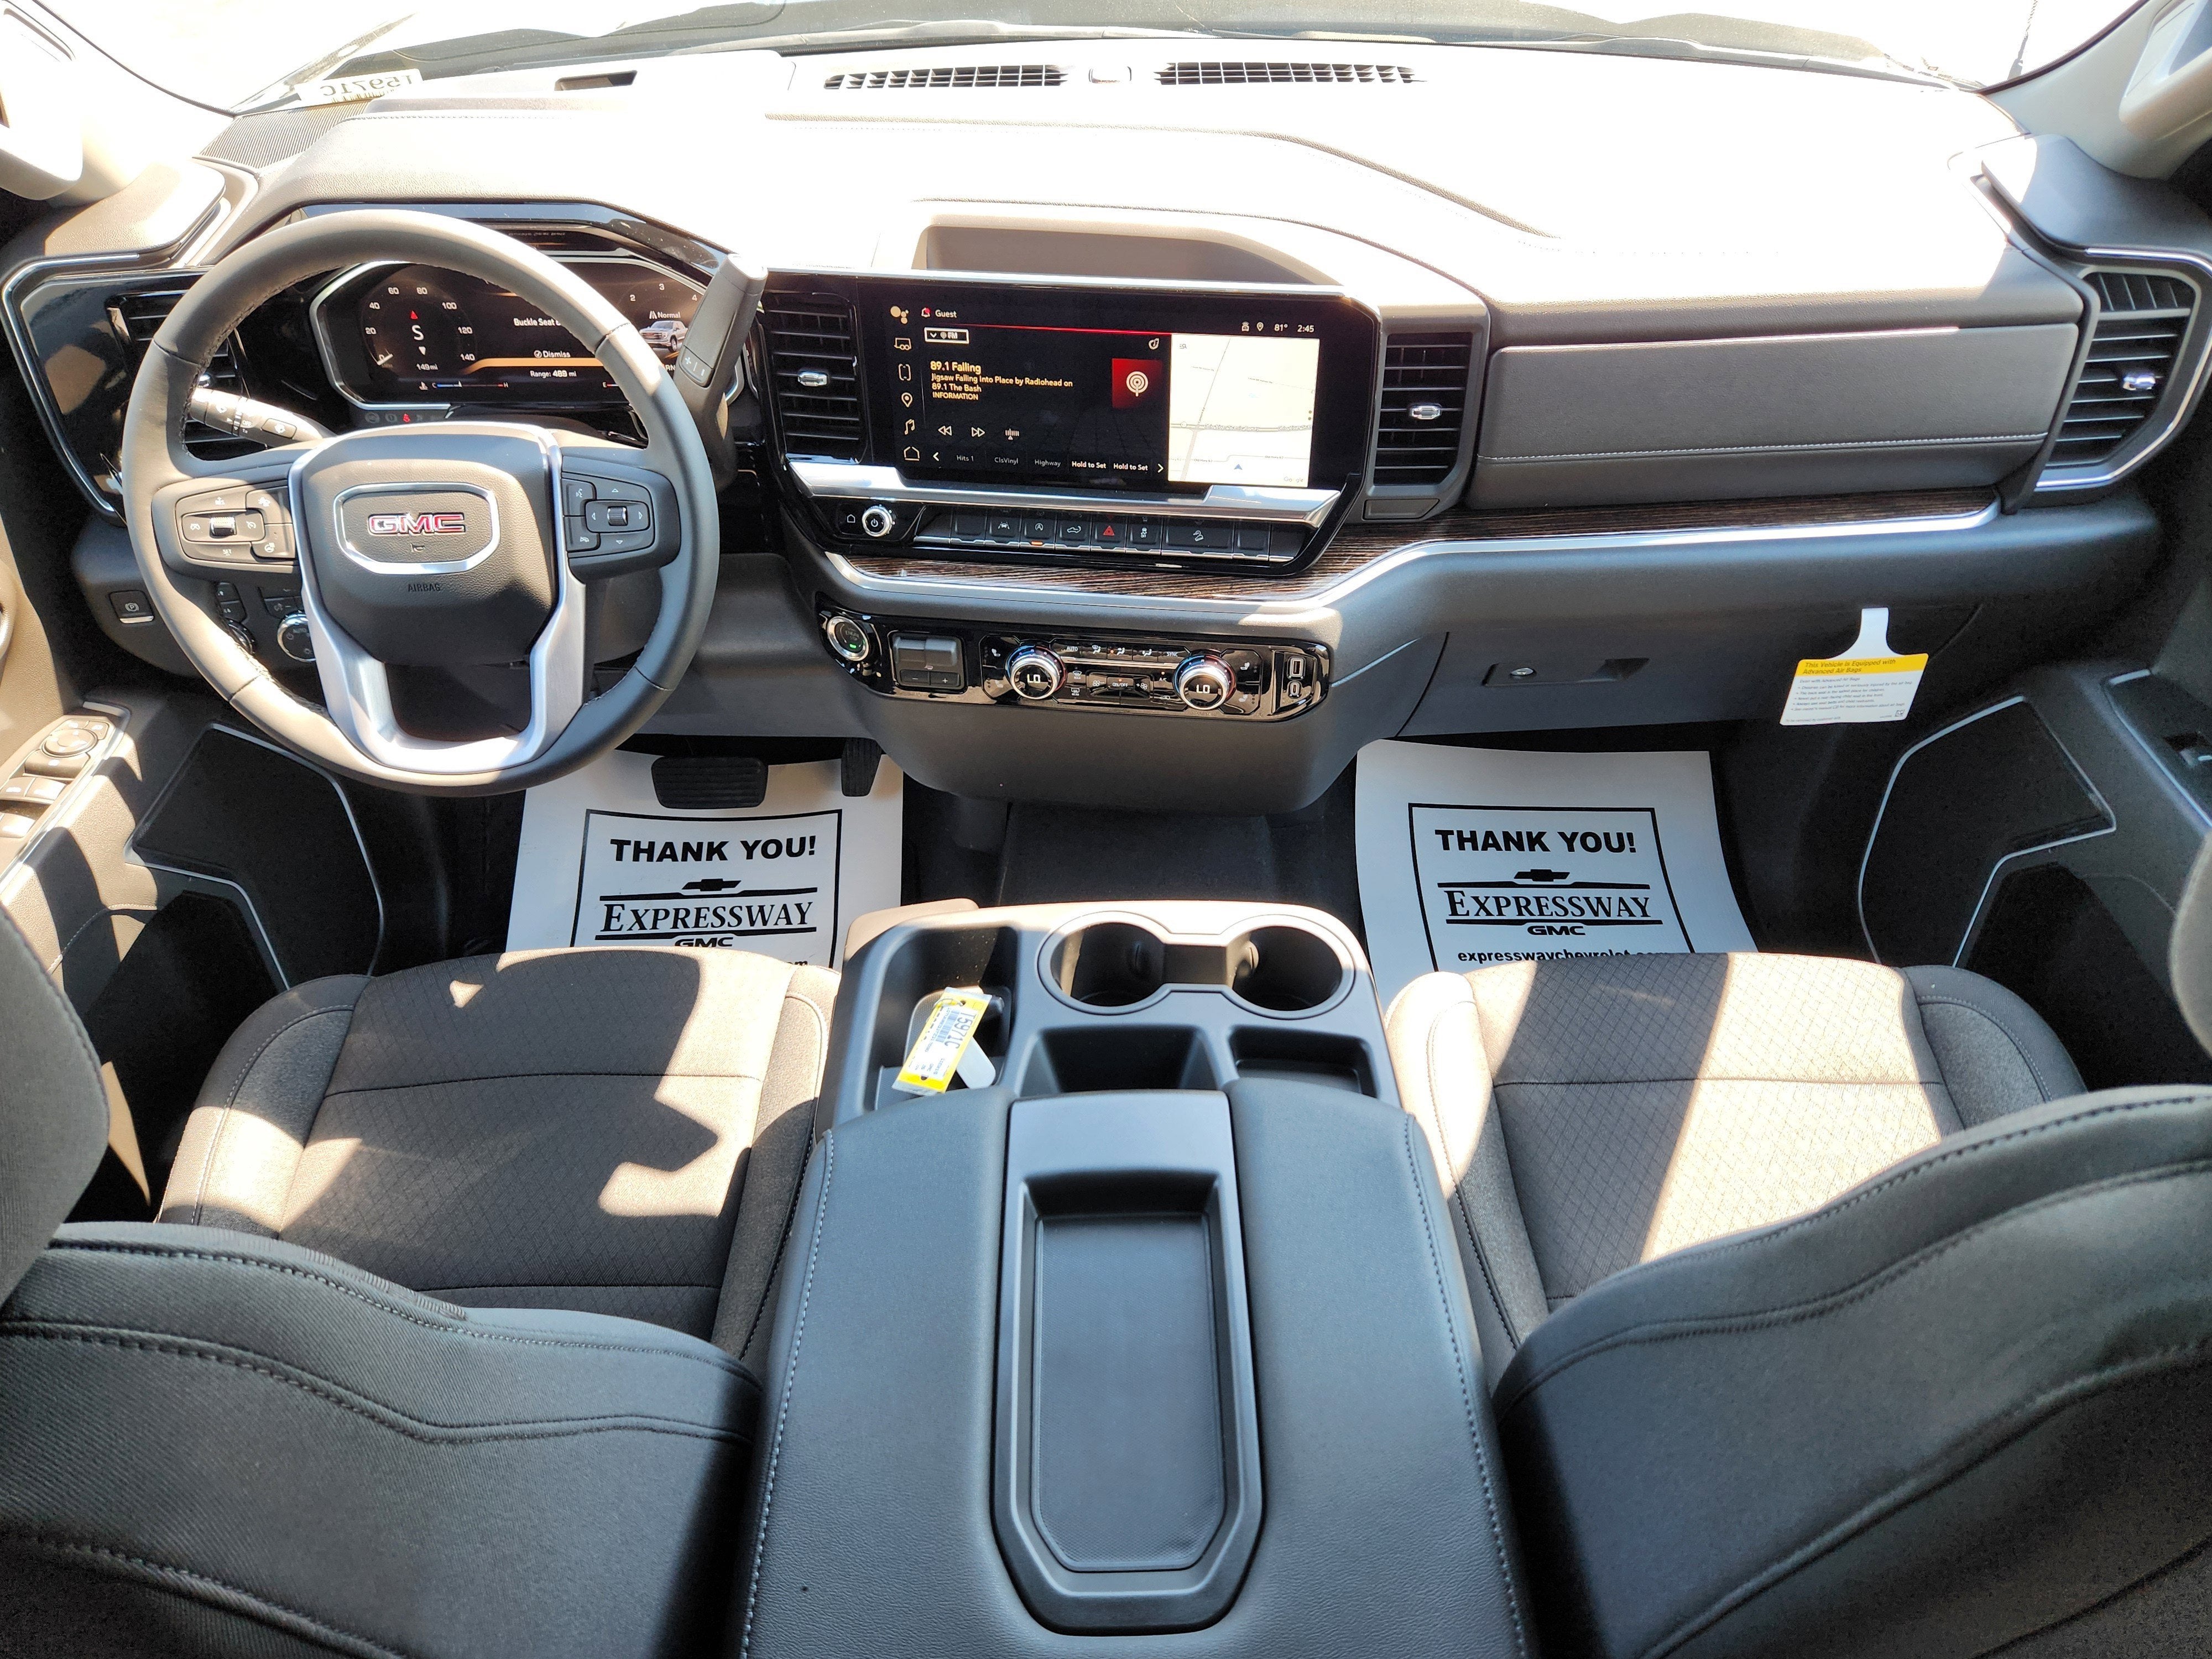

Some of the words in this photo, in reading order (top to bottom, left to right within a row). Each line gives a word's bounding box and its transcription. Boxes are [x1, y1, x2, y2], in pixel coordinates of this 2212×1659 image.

[388, 286, 399, 295] 60
[935, 310, 957, 319] Guest
[513, 318, 538, 326] Buckle
[538, 318, 555, 326] Seat
[411, 325, 424, 341] S
[544, 350, 571, 358] Dismiss
[930, 361, 950, 371] 89.1
[951, 362, 982, 374] Falling
[931, 373, 954, 383] Jigsaw
[955, 374, 978, 384] Falling
[995, 376, 1014, 384] Place
[1015, 377, 1024, 386] by
[1025, 377, 1062, 387] Radiohead
[949, 383, 963, 392] The
[932, 392, 979, 400] INFORMATION
[1035, 460, 1061, 468] Highway
[368, 513, 466, 535] GMC
[408, 583, 441, 592] AIRBAG
[1027, 674, 1040, 683] LO
[1196, 684, 1210, 694] LO
[1434, 830, 1551, 853] THANK
[1558, 832, 1637, 853] YOU!
[610, 838, 729, 862] THANK
[740, 835, 817, 860] YOU!
[1443, 890, 1651, 918] EXPRESSWAY
[601, 901, 814, 933] EXPRESSWAY
[1526, 925, 1586, 936] GMC
[675, 937, 733, 948] GMC
[945, 1012, 977, 1049] T5971C
